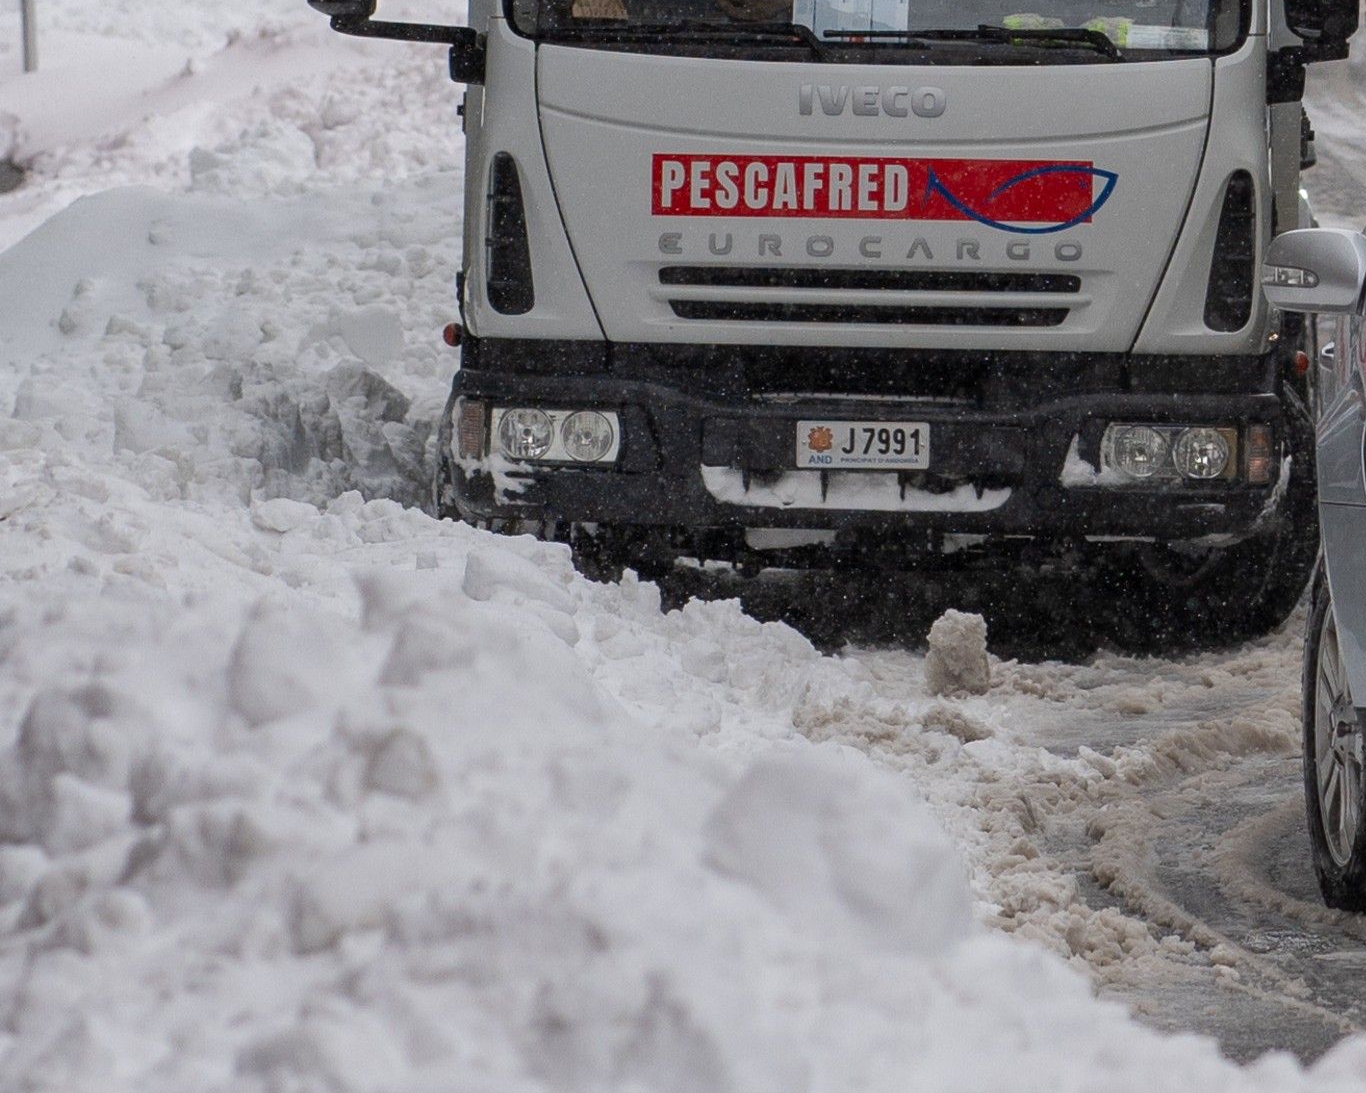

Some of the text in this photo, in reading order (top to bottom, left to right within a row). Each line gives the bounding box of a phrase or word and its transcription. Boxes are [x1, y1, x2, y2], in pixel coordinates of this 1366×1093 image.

[798, 83, 947, 119] IVECO
[661, 159, 909, 212] PESCAFRED
[657, 231, 1083, 262] EUROCARGO
[808, 454, 832, 465] AND
